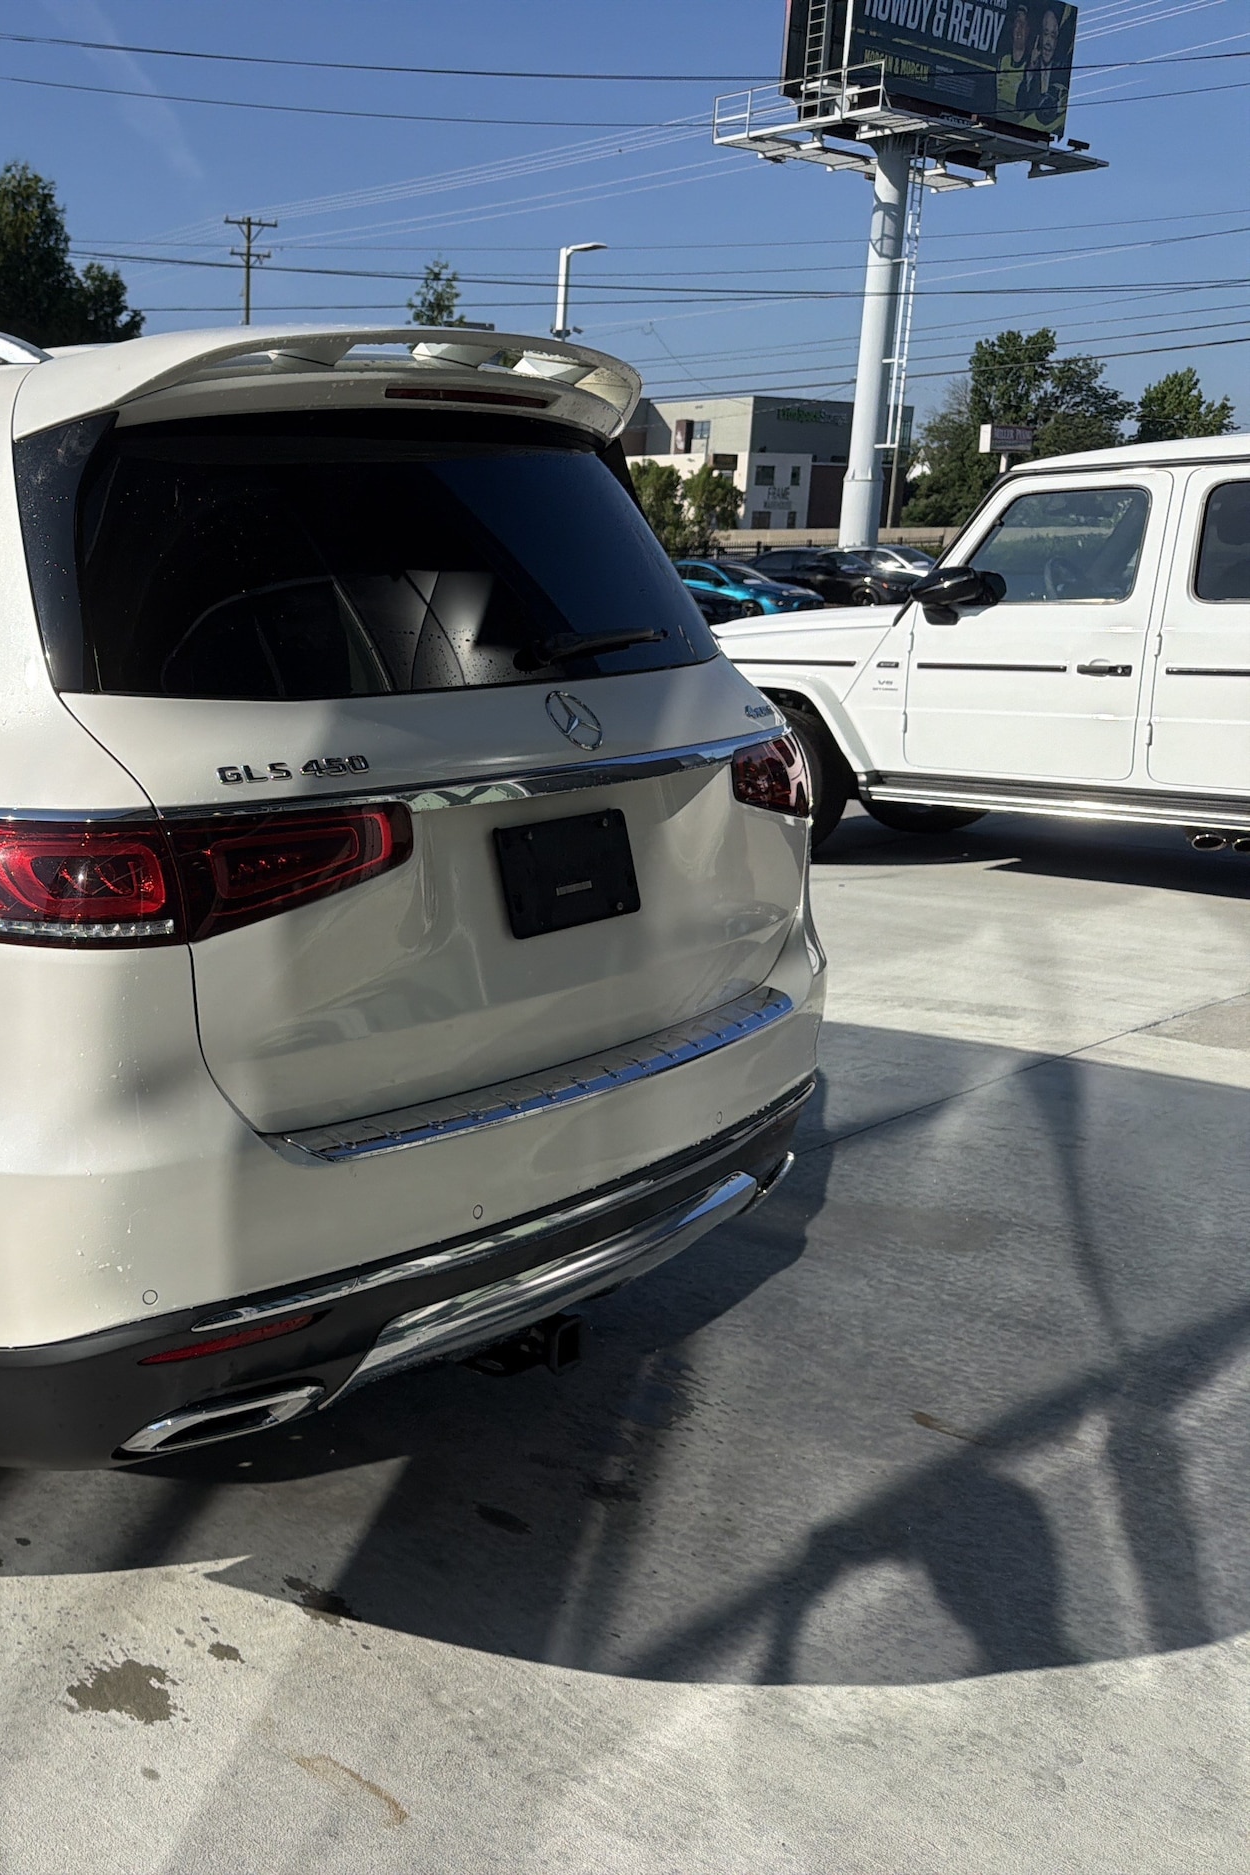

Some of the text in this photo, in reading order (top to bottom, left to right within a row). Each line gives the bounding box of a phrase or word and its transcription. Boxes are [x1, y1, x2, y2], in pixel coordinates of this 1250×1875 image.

[931, 0, 947, 39] &
[947, 0, 1006, 54] READY
[893, 57, 900, 74] &
[900, 59, 929, 75] MORGAN
[767, 487, 790, 500] FRAME
[216, 755, 369, 785] GLS 450
